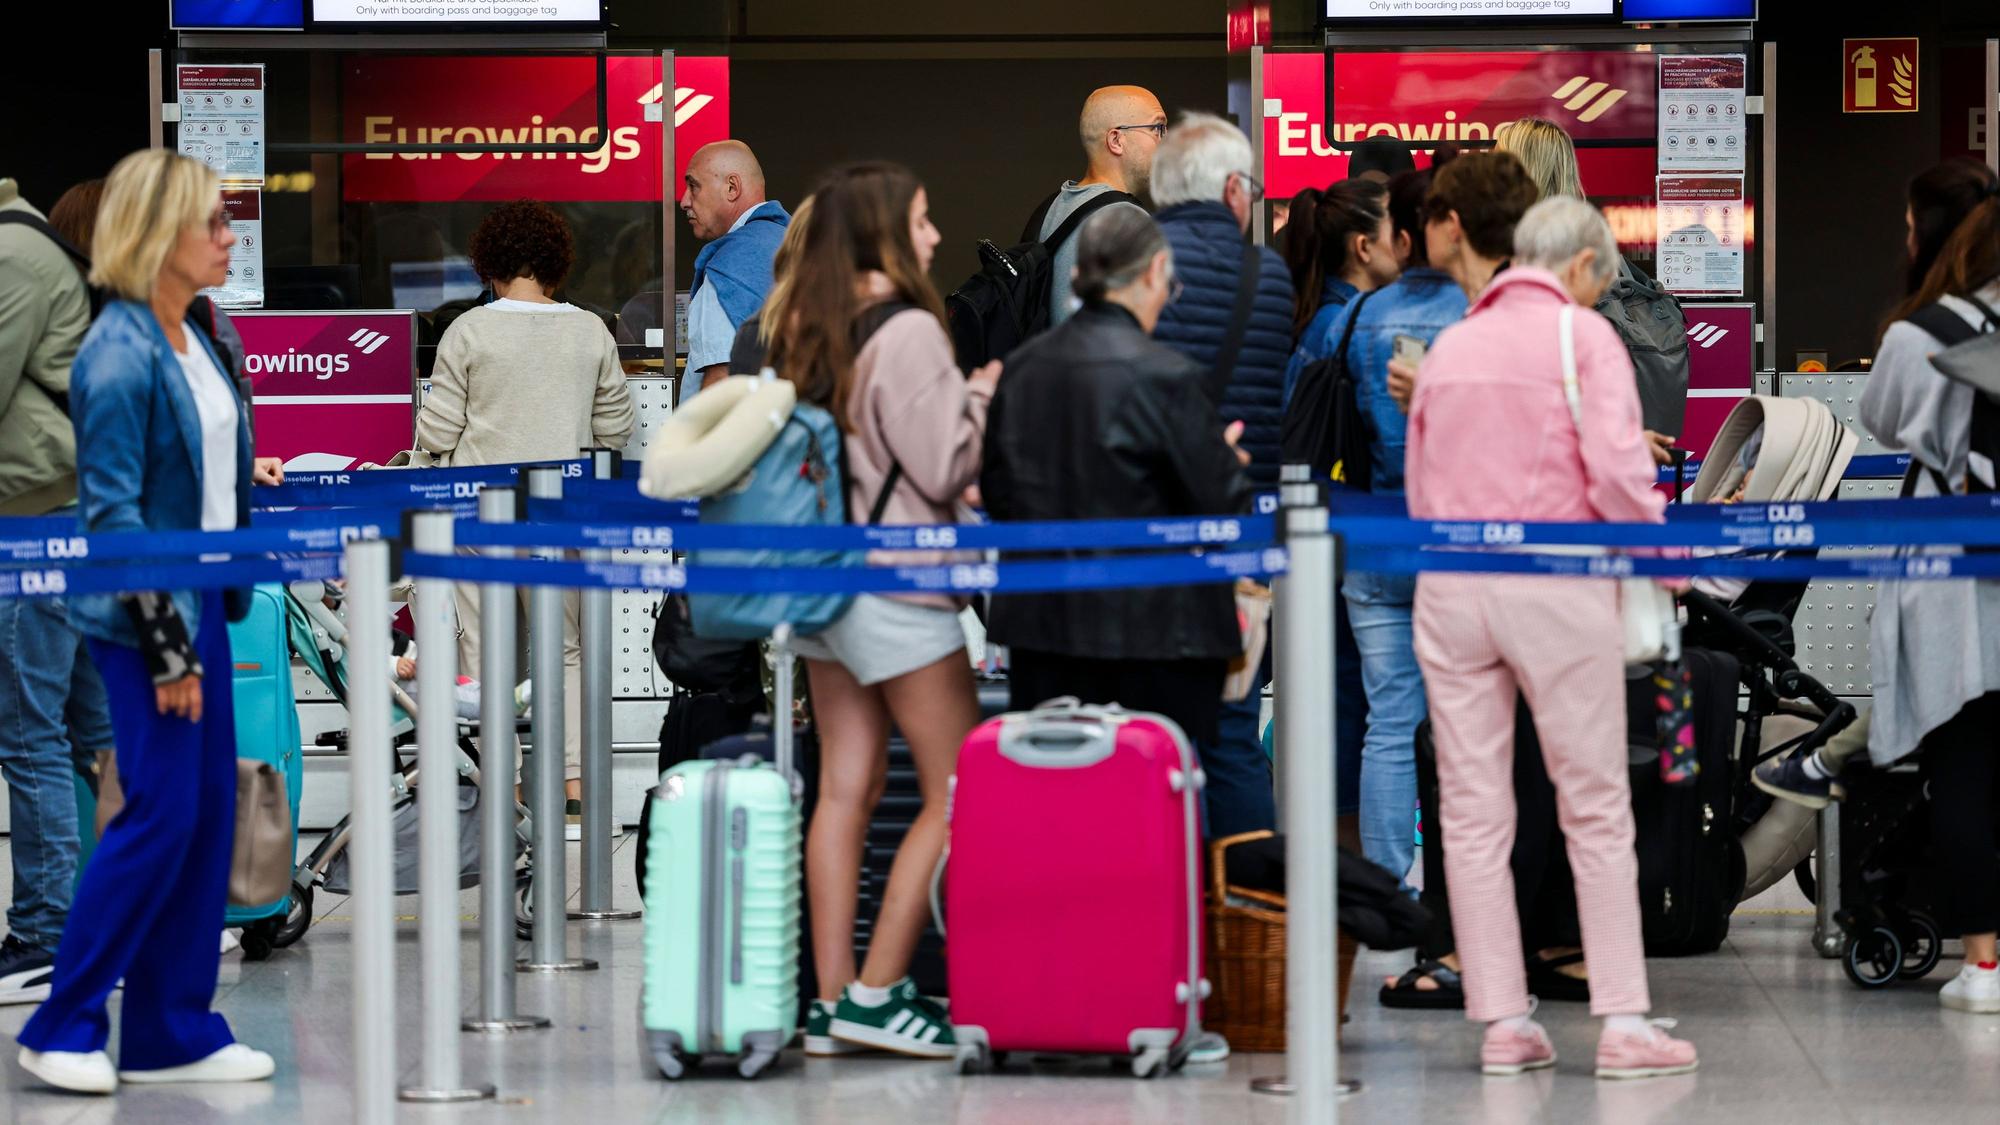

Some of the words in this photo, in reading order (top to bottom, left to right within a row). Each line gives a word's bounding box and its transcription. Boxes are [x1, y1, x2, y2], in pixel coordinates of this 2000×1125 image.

[356, 6, 378, 16] Only
[380, 5, 400, 15] with
[401, 5, 445, 16] boarding
[447, 7, 470, 16] pass
[472, 5, 491, 15] and
[493, 5, 538, 16] baggage
[540, 6, 557, 16] tag
[1369, 1, 1391, 11] Only
[1394, 1, 1412, 10] with
[1414, 0, 1457, 10] boarding
[1460, 1, 1482, 11] pass
[1484, 0, 1504, 9] and
[1506, 0, 1552, 10] baggage
[1554, 0, 1570, 9] tag
[365, 115, 641, 173] Eurowings
[243, 347, 350, 380] owings
[562, 463, 582, 477] US
[1768, 504, 1806, 523] DUS
[1773, 524, 1815, 546] DUS
[47, 536, 89, 558] DUS
